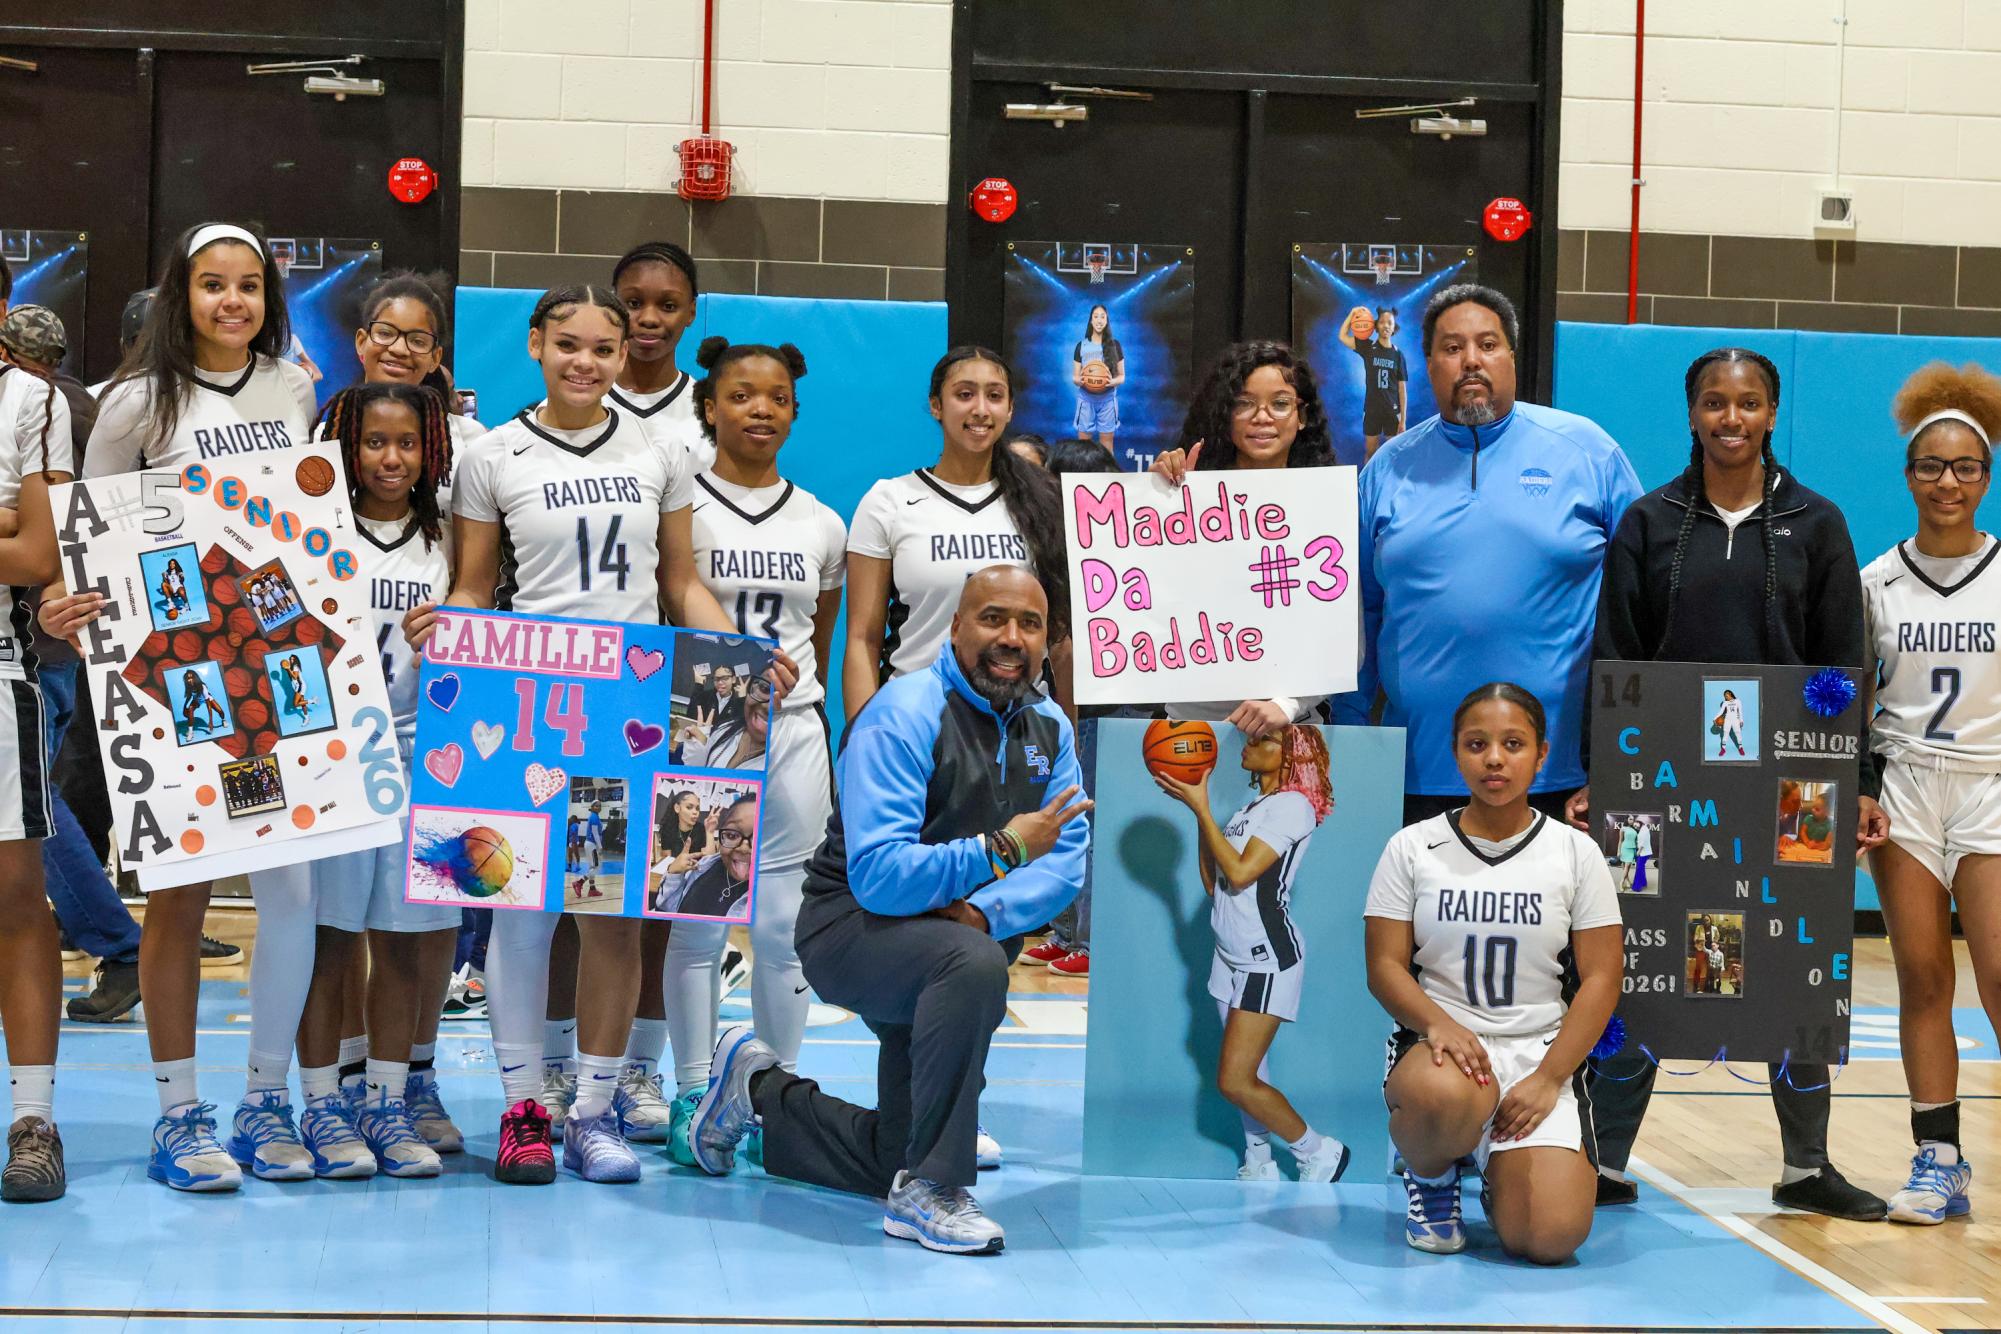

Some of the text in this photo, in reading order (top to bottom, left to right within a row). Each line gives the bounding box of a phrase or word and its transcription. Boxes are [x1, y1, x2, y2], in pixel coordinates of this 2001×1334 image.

[400, 161, 423, 169] STOP
[985, 181, 1008, 189] STOP
[1378, 369, 1389, 389] 13
[194, 420, 292, 460] RAIDERS
[101, 473, 184, 535] #5
[543, 476, 642, 510] RAIDERS
[186, 465, 355, 577] SENIOR
[1074, 481, 1290, 549] Maddie
[1774, 526, 1791, 536] alo
[223, 525, 254, 552] OFFENSE
[577, 514, 630, 592] 14
[931, 534, 1027, 561] RAIDERS
[711, 549, 806, 582] RAIDERS
[1081, 535, 1348, 612] Da #3
[371, 577, 432, 612] IDERS
[426, 617, 618, 673] CAMILLE
[1088, 611, 1264, 678] Baddie
[1898, 622, 1996, 652] RAIDERS
[59, 483, 173, 862] ALEASA
[1601, 673, 1641, 708] 14
[1925, 667, 1962, 741] 2
[512, 678, 588, 756] 14
[1173, 740, 1212, 754] ELITE
[1773, 730, 1858, 754] SENIOR
[352, 706, 404, 815] 26
[1024, 745, 1050, 775] ER
[1438, 889, 1542, 925] RAIDERS
[1624, 927, 1667, 947] ASS
[1462, 933, 1517, 1007] 10
[1622, 974, 1676, 994] 026!
